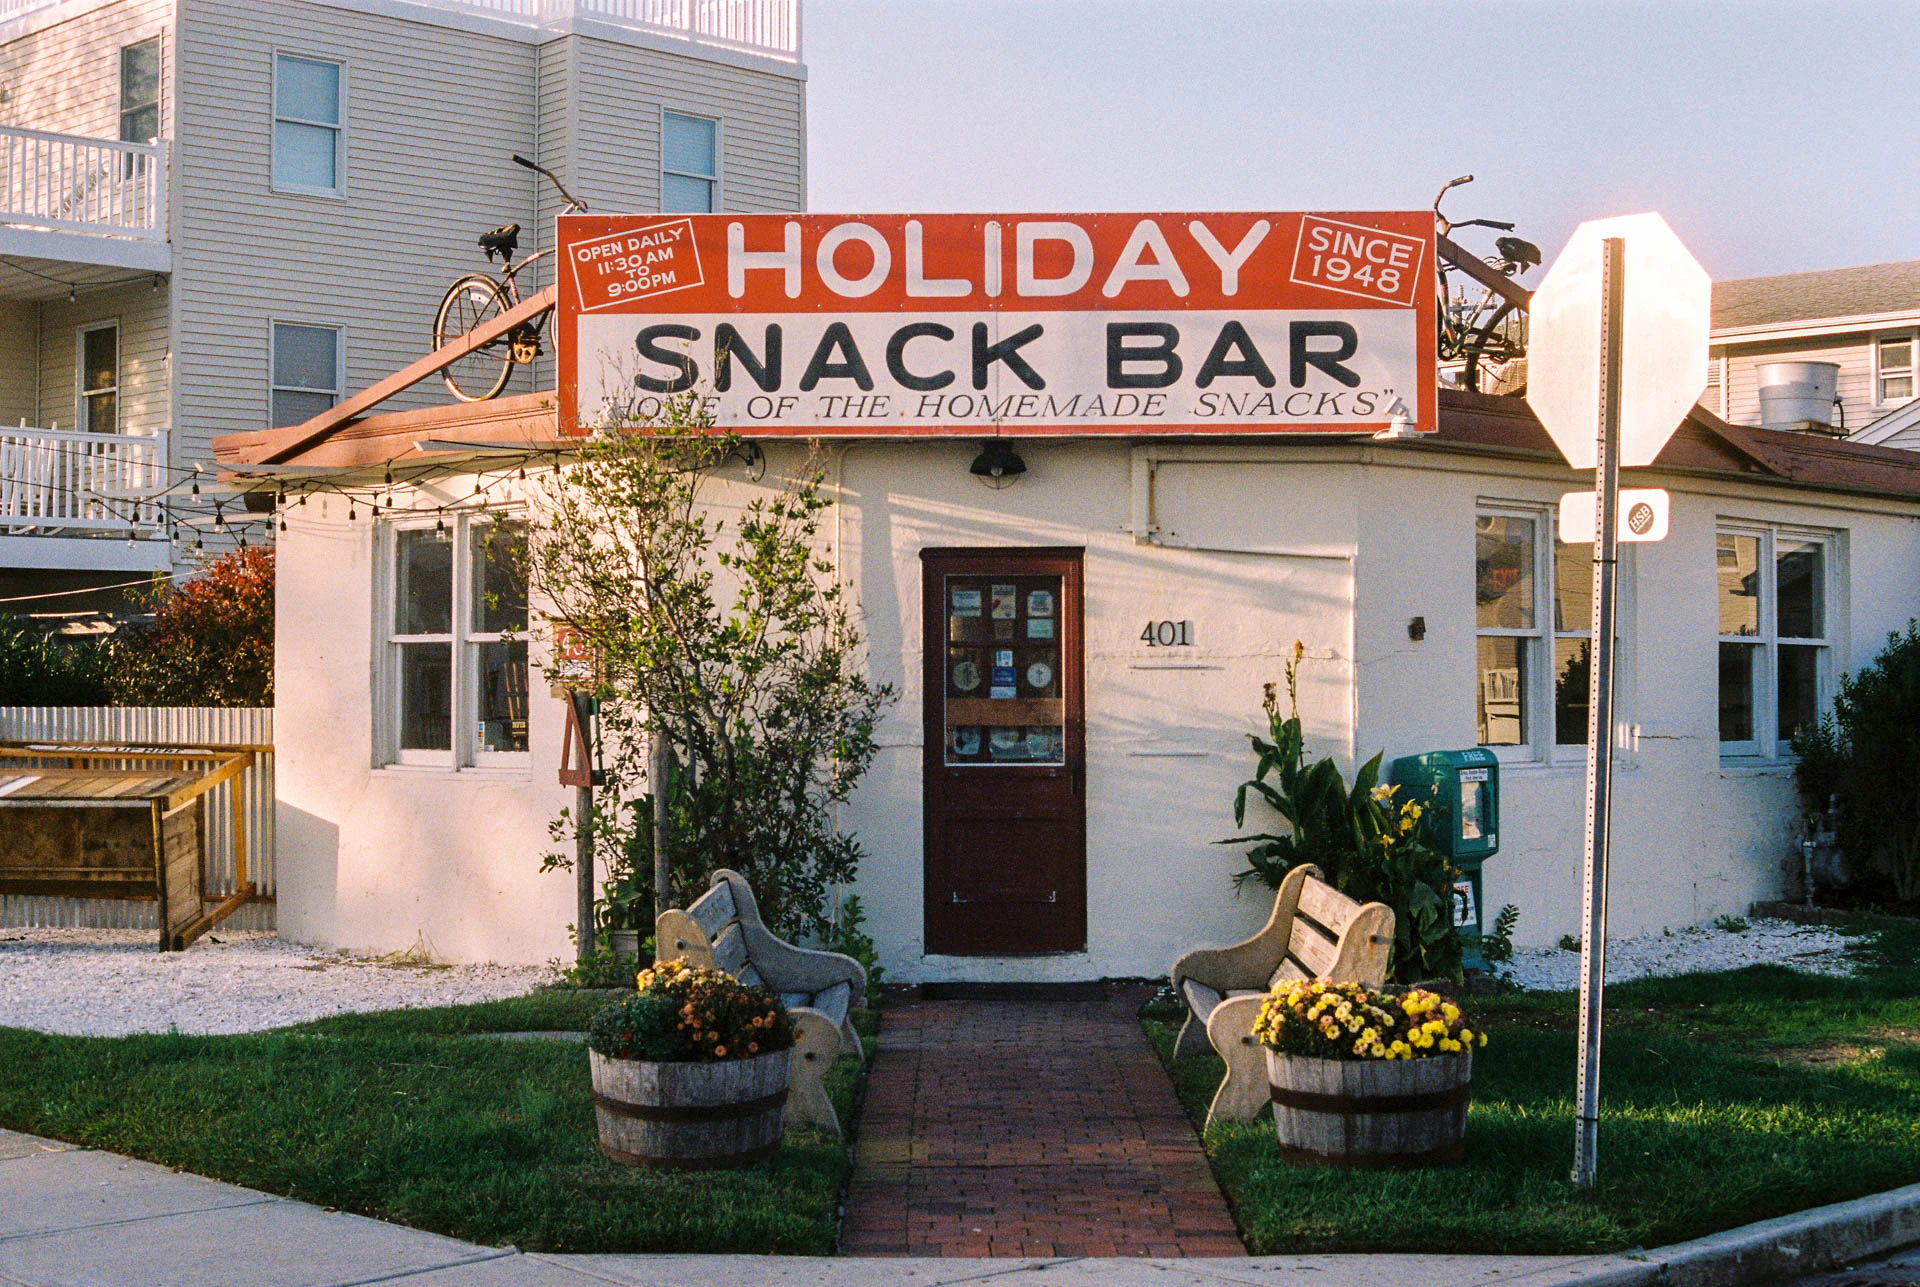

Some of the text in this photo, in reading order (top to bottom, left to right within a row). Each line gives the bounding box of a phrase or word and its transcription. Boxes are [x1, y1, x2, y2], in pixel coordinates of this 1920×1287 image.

[577, 227, 684, 262] OPEN DAILY
[727, 219, 1271, 299] HOLIDAY
[1308, 226, 1414, 268] SINCE
[597, 246, 674, 275] 11:30 AM
[625, 265, 650, 278] TO
[1312, 254, 1400, 293] 1948
[607, 270, 677, 297] 9:00 PM
[634, 320, 1361, 394] SNACK BAR
[746, 396, 799, 420] OF
[820, 395, 891, 418] THE
[914, 393, 1168, 418] HOMEMADE
[1193, 388, 1395, 417] SNACKS"
[1630, 505, 1650, 530] HSB
[1140, 620, 1190, 647] 401
[1461, 750, 1486, 762] FREE
